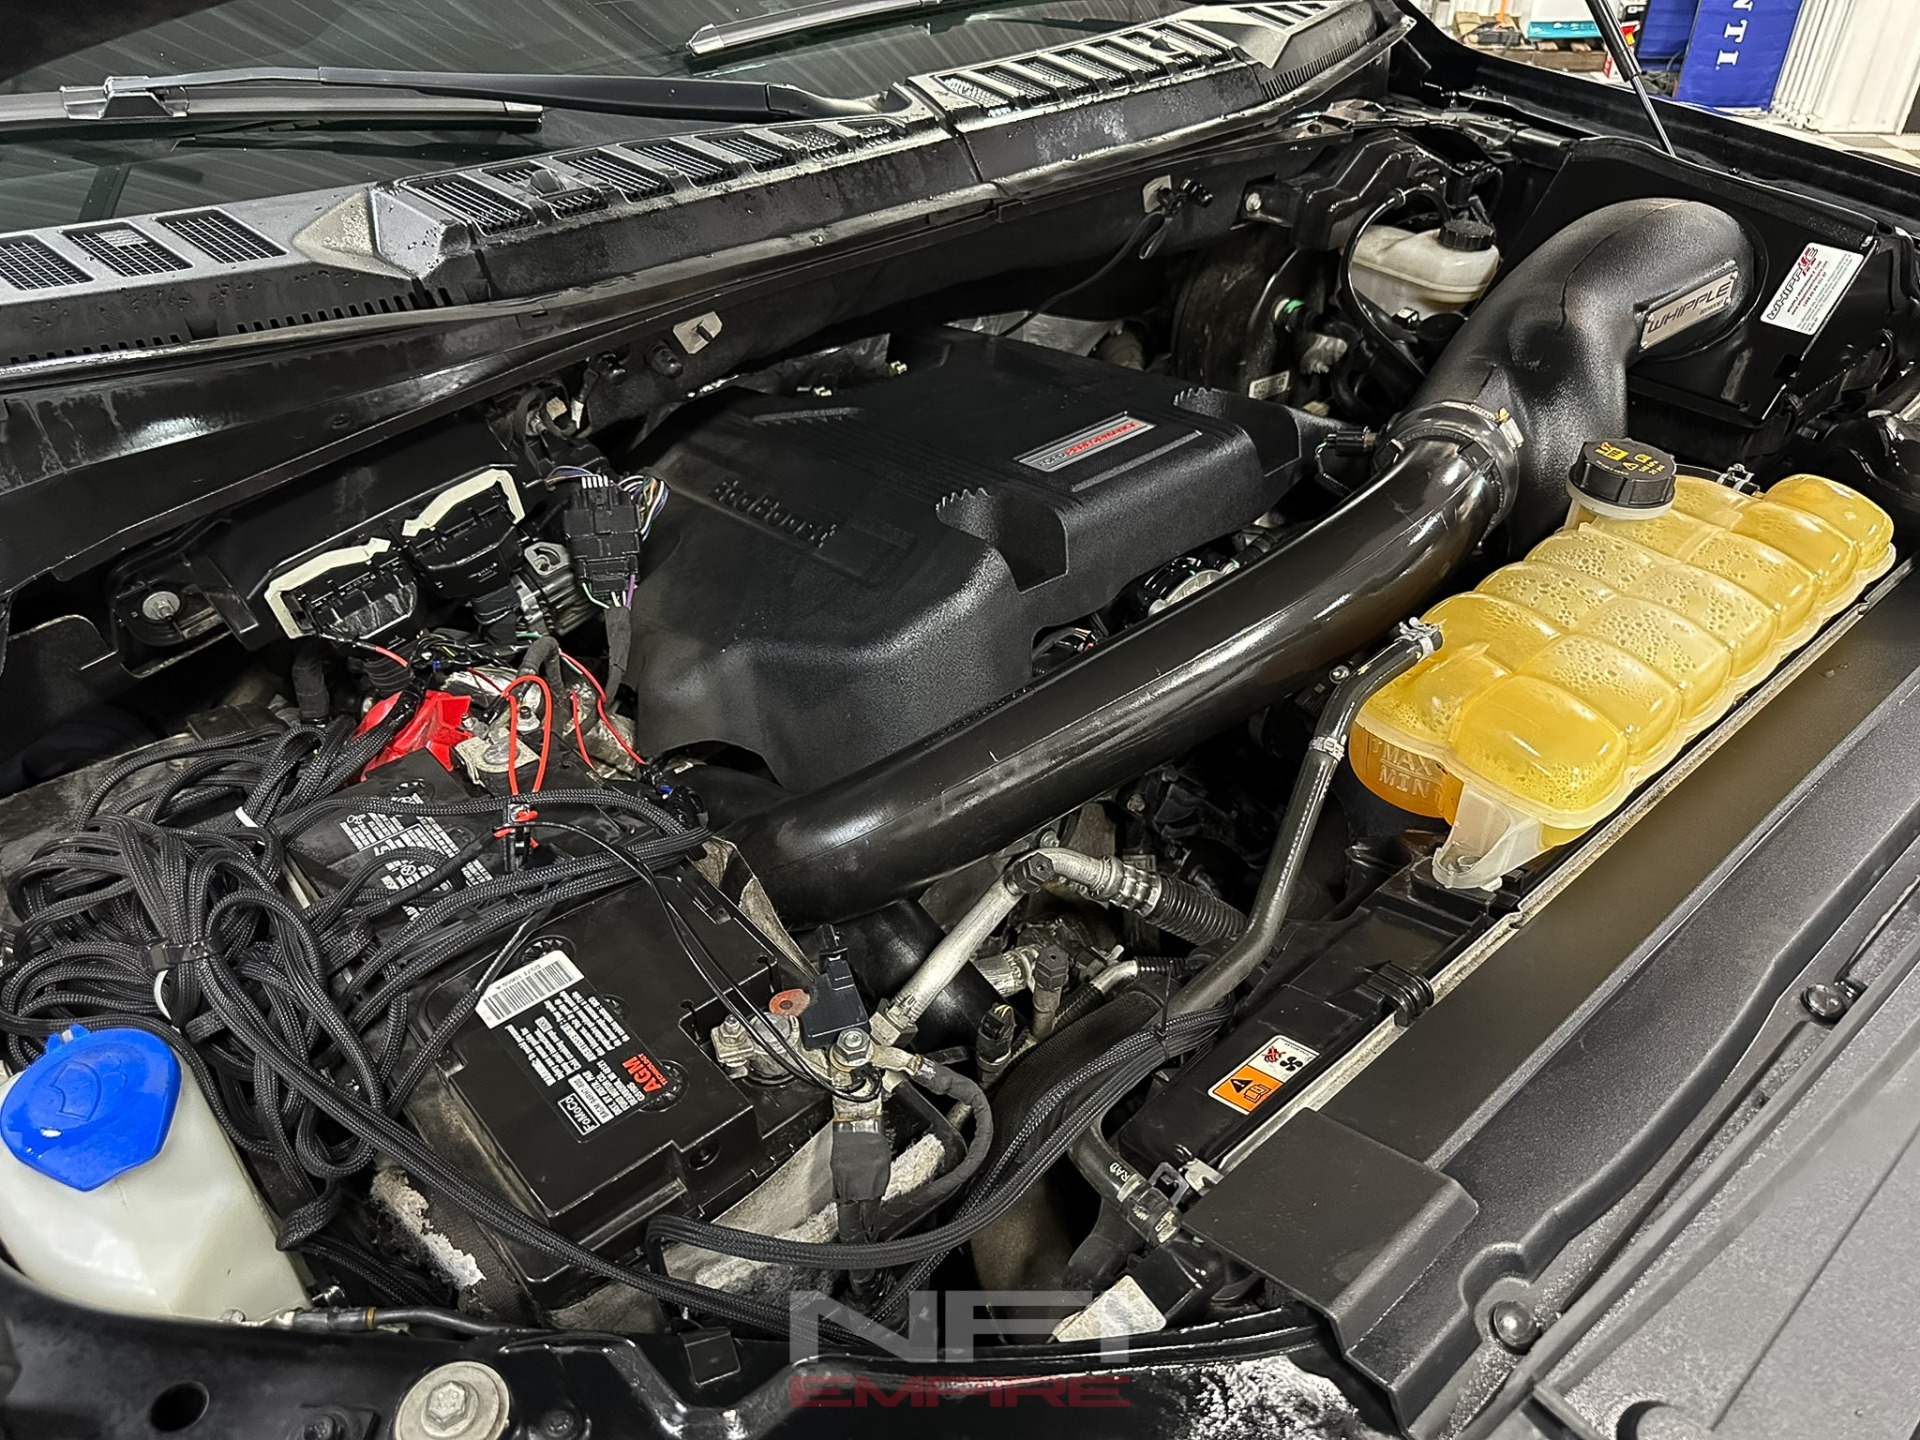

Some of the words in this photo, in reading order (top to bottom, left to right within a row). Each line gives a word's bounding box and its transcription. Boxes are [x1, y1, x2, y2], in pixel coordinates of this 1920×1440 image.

[1766, 247, 1818, 320] WHIPPLE
[1647, 281, 1732, 334] WHIPPLE
[1064, 419, 1141, 458] PERFORMANCE
[1383, 742, 1433, 776] MAX
[1379, 764, 1431, 799] MIN
[622, 1055, 661, 1095] AGM
[638, 1052, 667, 1086] TECHNOLOGY
[563, 1095, 597, 1132] FoMoCo
